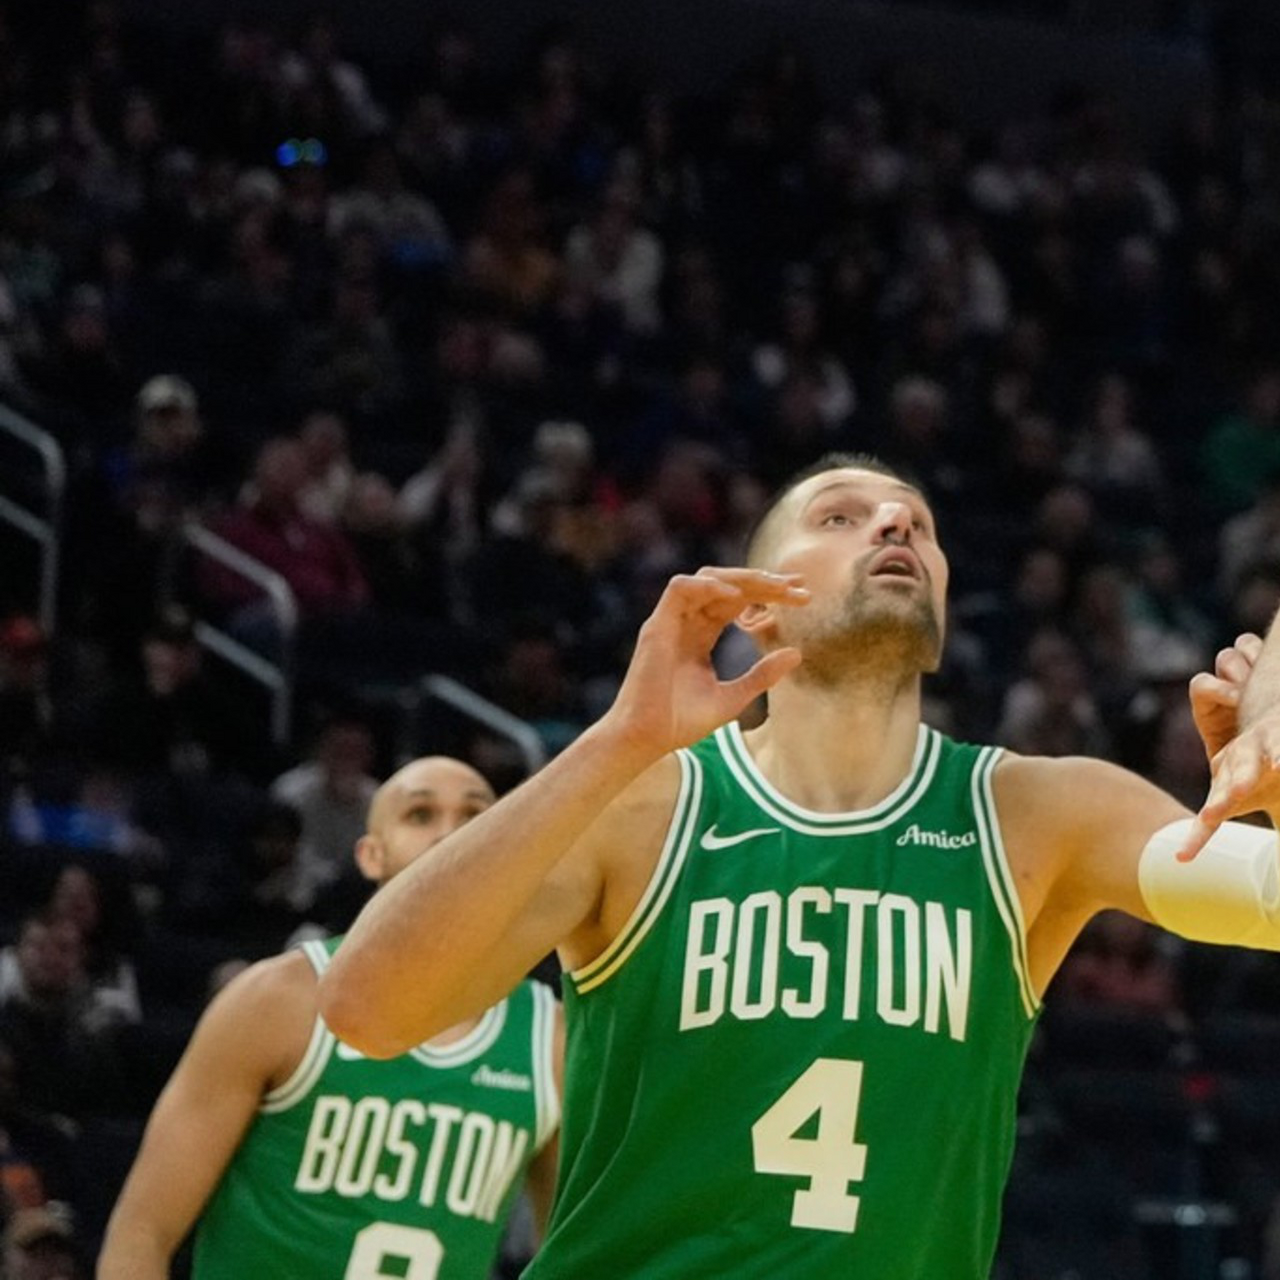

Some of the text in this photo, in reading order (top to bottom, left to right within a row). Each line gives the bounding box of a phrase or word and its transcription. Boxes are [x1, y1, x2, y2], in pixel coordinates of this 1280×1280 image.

[896, 824, 977, 849] Amica
[680, 886, 971, 1041] BOSTON
[294, 1095, 529, 1222] BOSTON
[752, 1058, 867, 1233] 4
